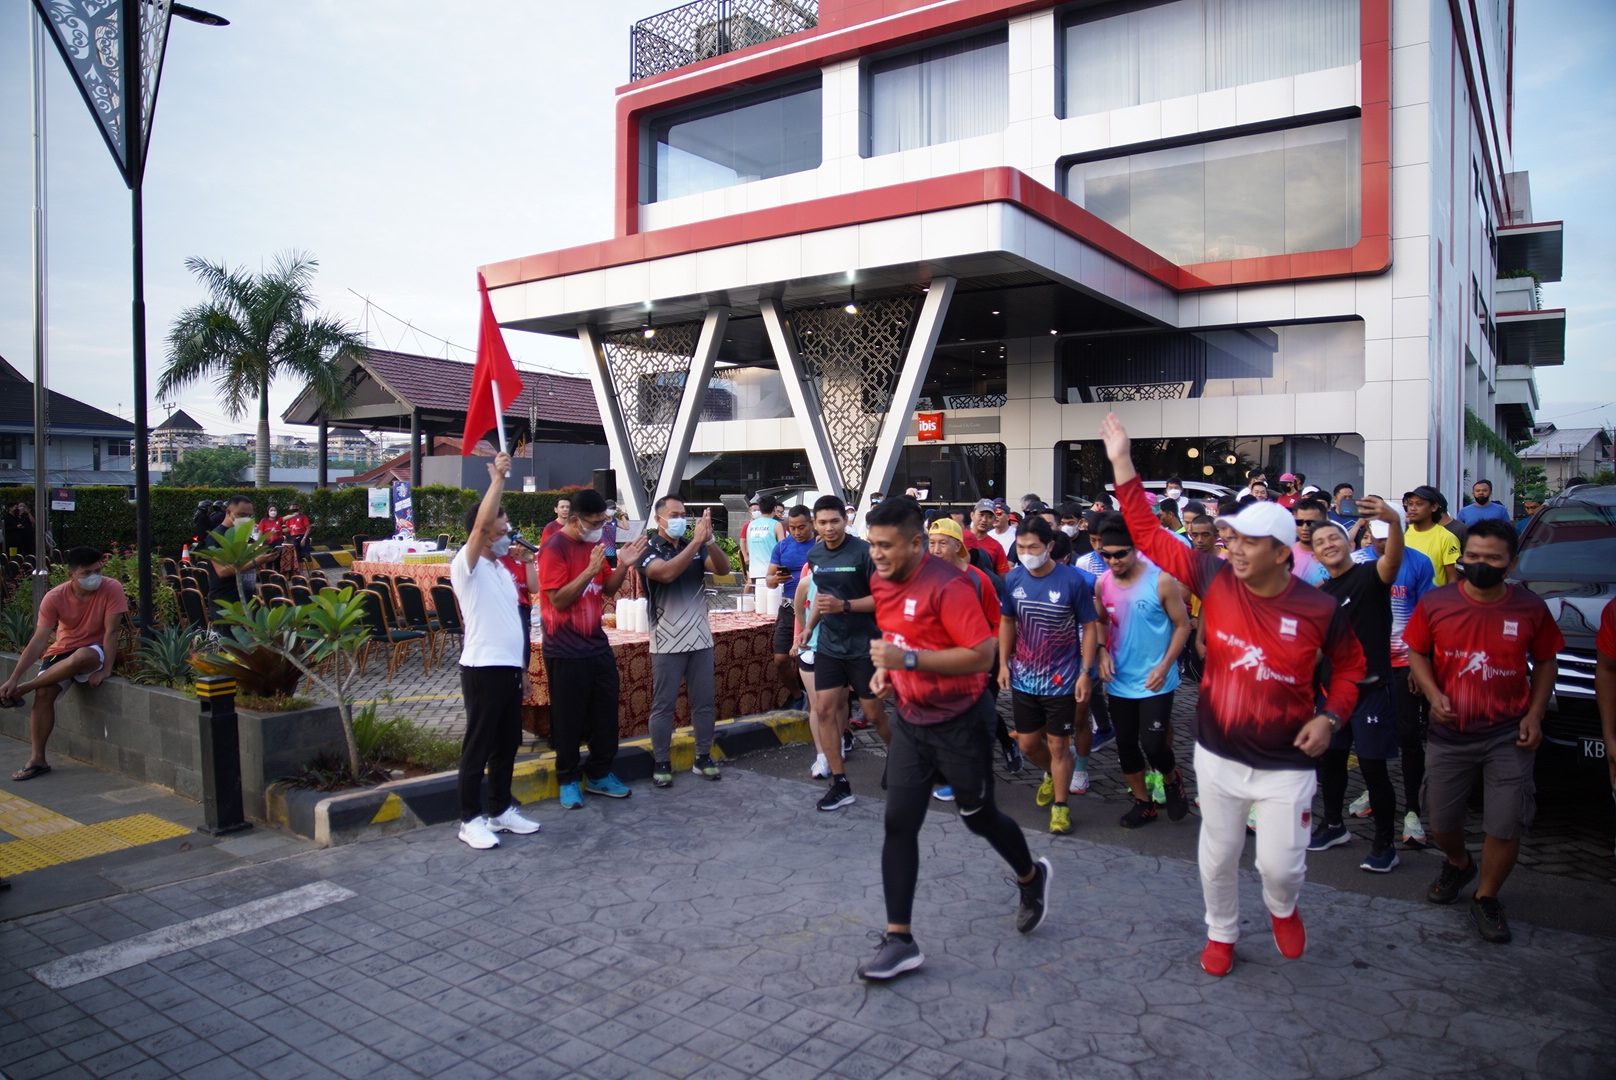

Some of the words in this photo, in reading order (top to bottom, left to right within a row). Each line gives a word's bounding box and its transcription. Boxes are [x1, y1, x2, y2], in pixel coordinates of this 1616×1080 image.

[919, 420, 936, 431] ibis
[1205, 507, 1218, 517] bis
[1391, 585, 1407, 599] AR
[1584, 740, 1605, 758] KB
